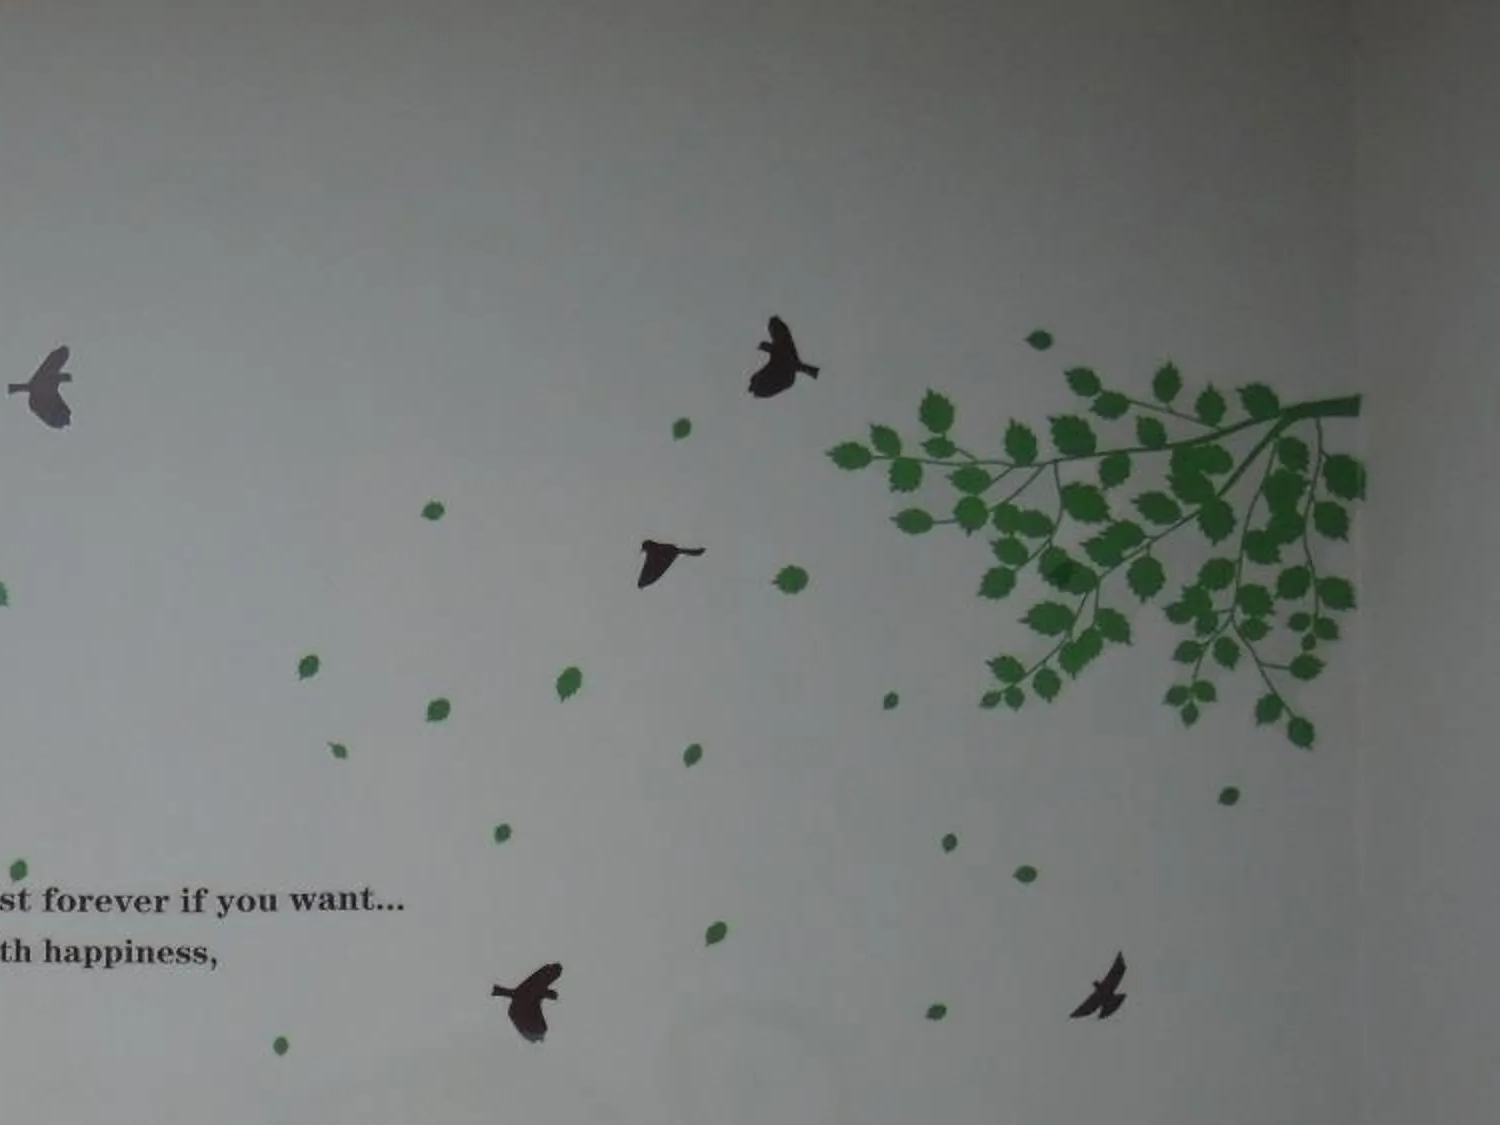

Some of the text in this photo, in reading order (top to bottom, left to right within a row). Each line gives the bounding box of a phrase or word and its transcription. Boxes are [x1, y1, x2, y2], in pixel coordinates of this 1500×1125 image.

[42, 886, 171, 914] forever
[181, 887, 209, 914] if
[216, 892, 277, 920] you
[289, 888, 405, 914] want...
[43, 938, 218, 971] happiness,
